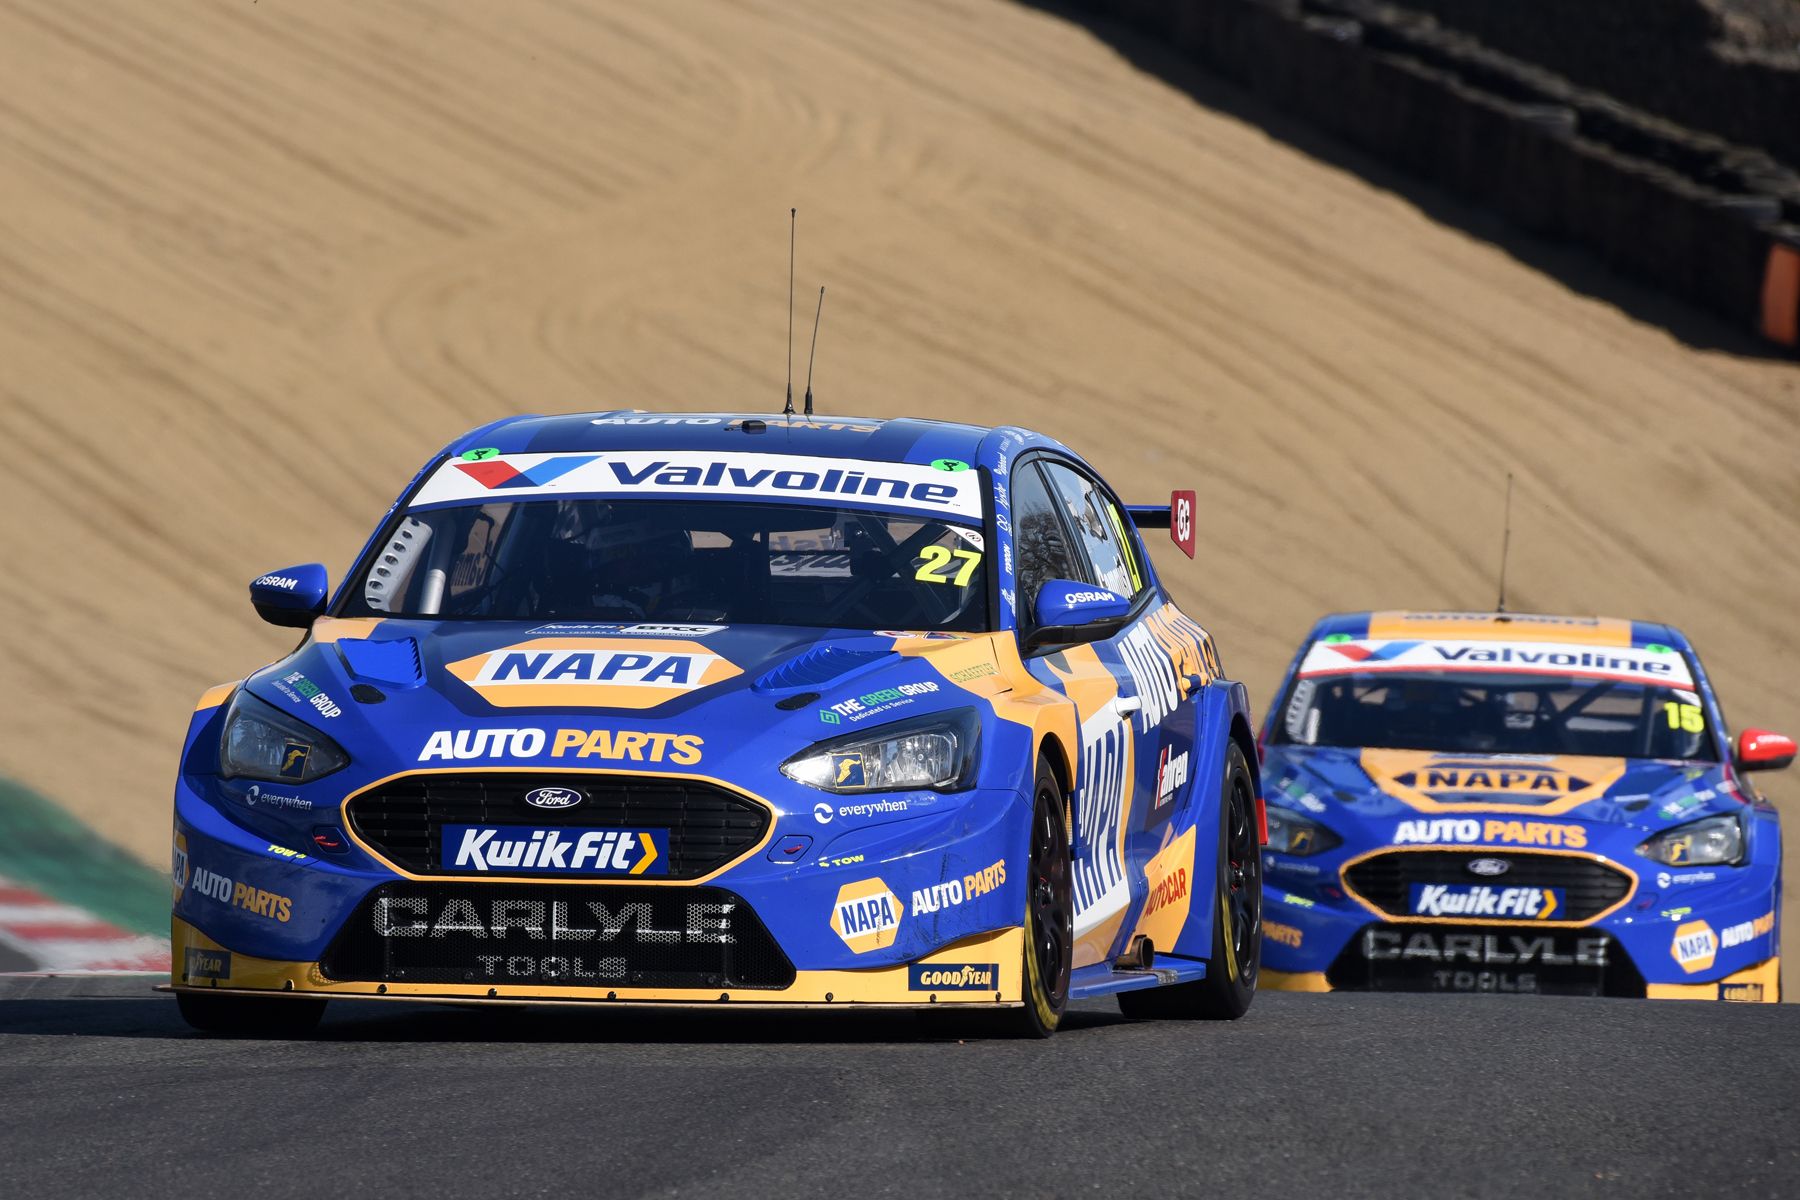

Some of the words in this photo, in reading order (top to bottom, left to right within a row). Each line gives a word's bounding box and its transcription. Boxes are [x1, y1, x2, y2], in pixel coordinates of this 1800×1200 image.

[607, 461, 959, 504] Valvoline
[915, 545, 982, 587] 27
[255, 575, 298, 590] OSRAM
[1064, 592, 1115, 604] OSRAM
[490, 652, 693, 685] NAPA
[1432, 645, 1672, 675] Valvoline
[282, 671, 305, 684] THE
[293, 678, 322, 699] GREEN
[309, 692, 342, 718] GROUP
[830, 698, 866, 717] THE
[859, 687, 905, 706] GREEN
[897, 681, 940, 696] GROUP
[849, 705, 884, 722] Dedicated
[890, 698, 915, 708] Service
[1664, 702, 1704, 733] 15
[417, 728, 546, 761] AUTO
[550, 728, 705, 765] PARTS
[1427, 772, 1559, 792] NAPA
[260, 792, 313, 810] everywhen
[535, 789, 571, 805] Ford
[839, 800, 908, 818] everywhen
[1393, 818, 1481, 844] AUTO
[1483, 820, 1588, 848] PARTS
[267, 844, 296, 857] TOW
[832, 854, 865, 867] TOW
[192, 867, 232, 903] AUTO
[232, 882, 293, 922] PARTS
[912, 879, 963, 917] AUTO
[964, 858, 1006, 901] PARTS
[1143, 867, 1187, 919] AUTOCAR
[372, 896, 737, 943] CARLYLE
[841, 896, 895, 934] NAPA
[1362, 928, 1609, 966] CARLYLE
[1678, 934, 1713, 960] NAPA
[477, 954, 628, 978] TOOLS
[1434, 970, 1536, 991] TOOLS
